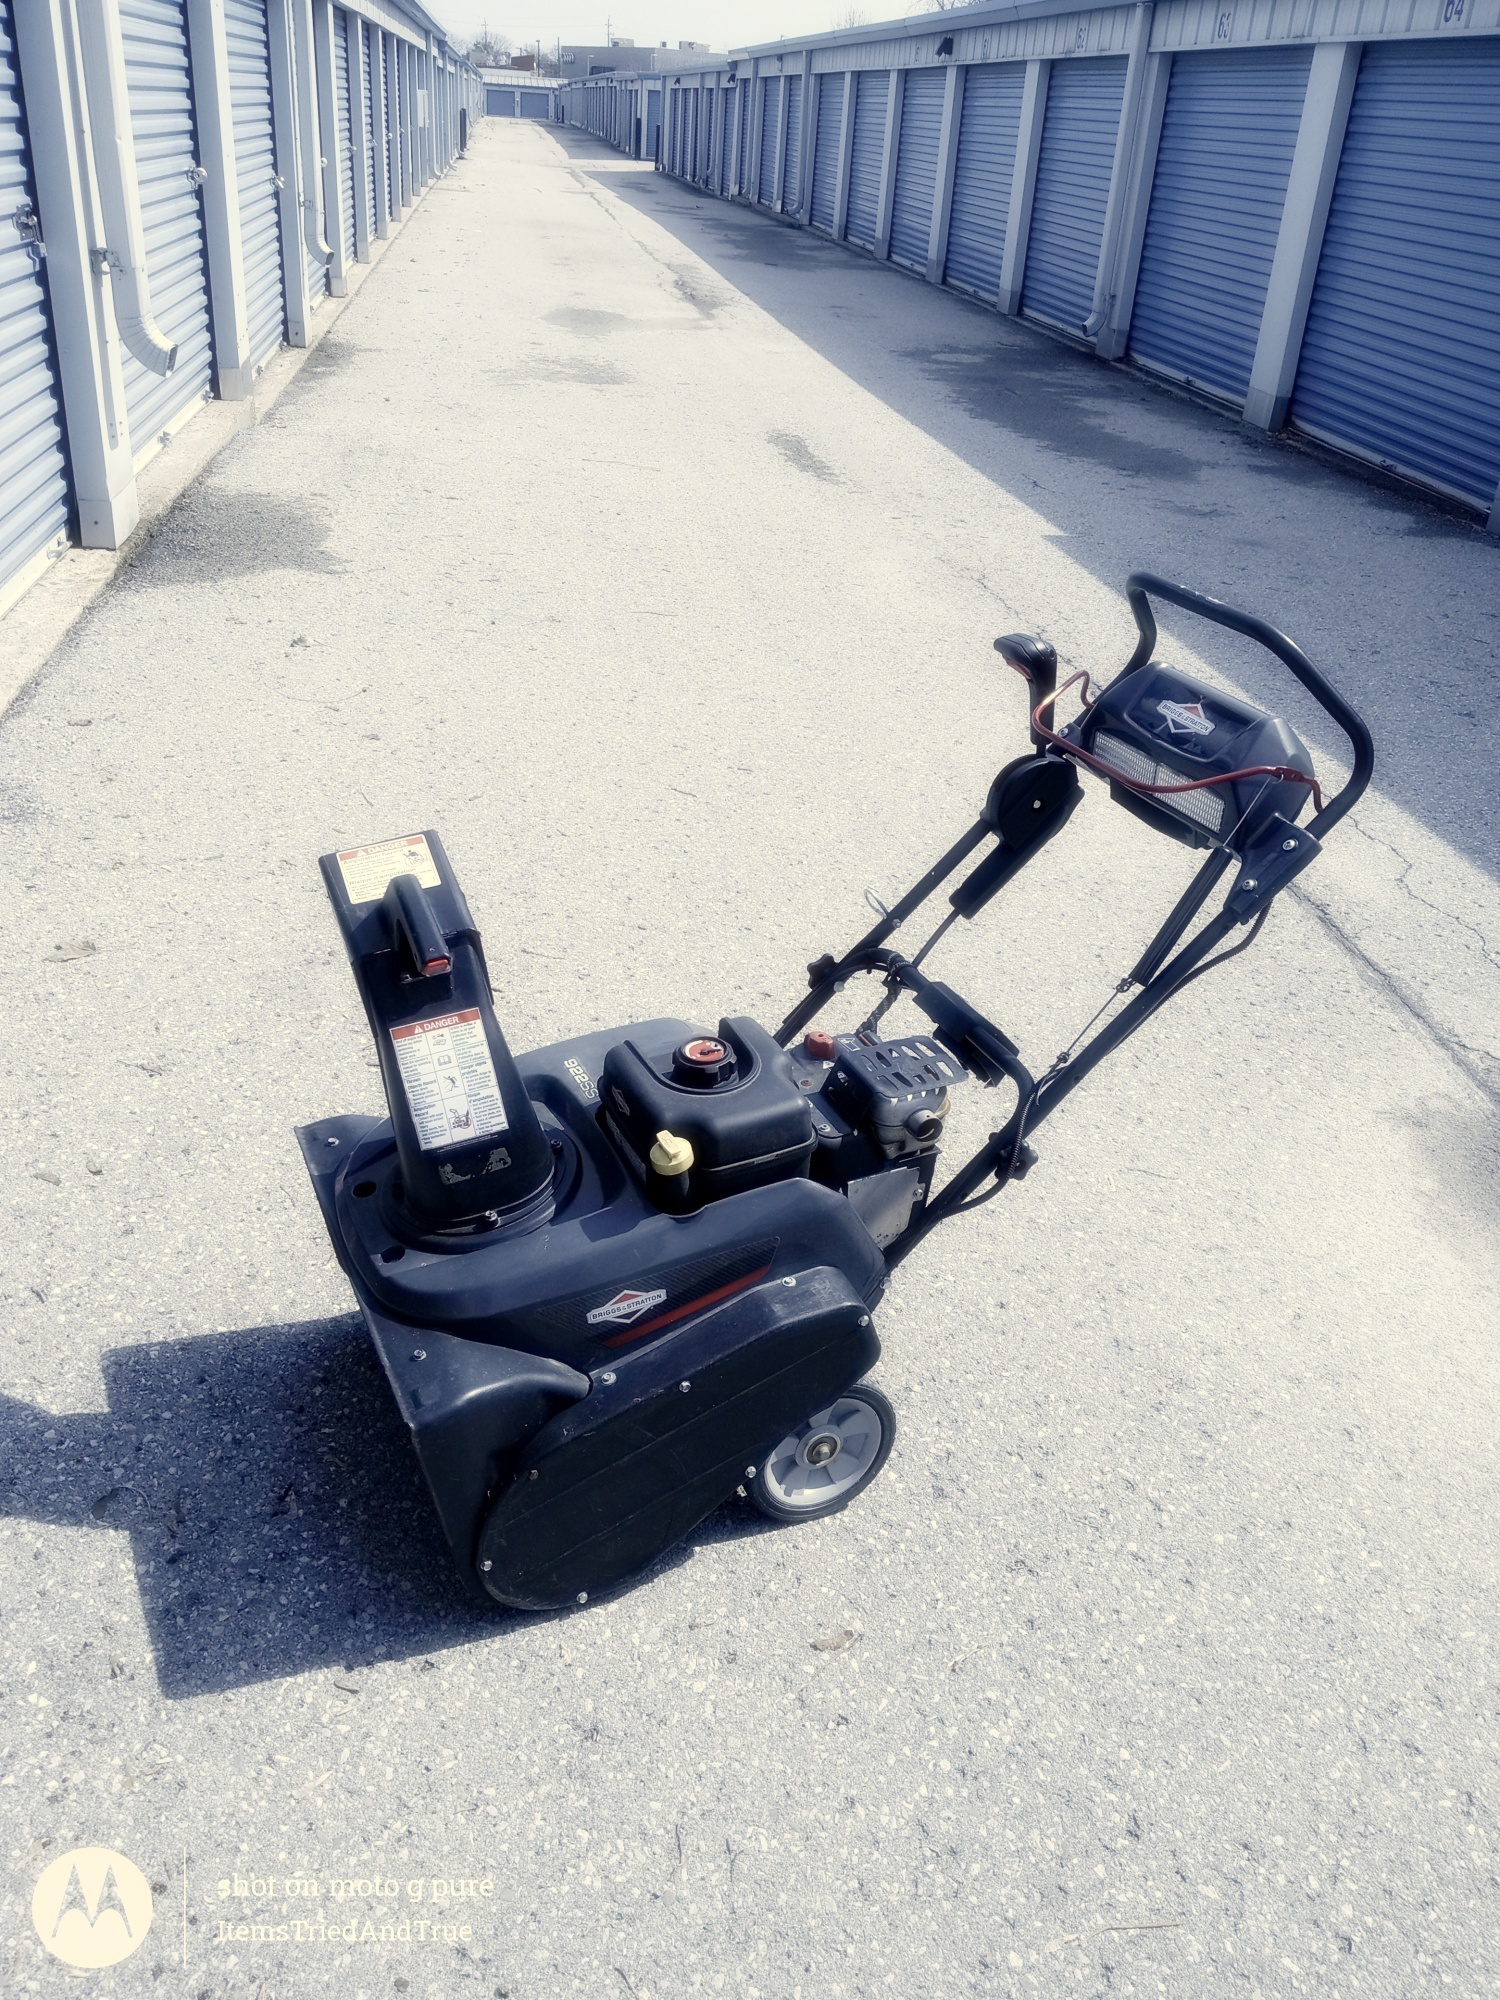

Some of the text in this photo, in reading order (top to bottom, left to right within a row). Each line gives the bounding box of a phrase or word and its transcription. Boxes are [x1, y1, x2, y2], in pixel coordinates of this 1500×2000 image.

[1444, 0, 1465, 22] 64
[367, 840, 409, 854] DANGER
[423, 1016, 460, 1031] DANGER
[563, 1058, 599, 1099] 922SS
